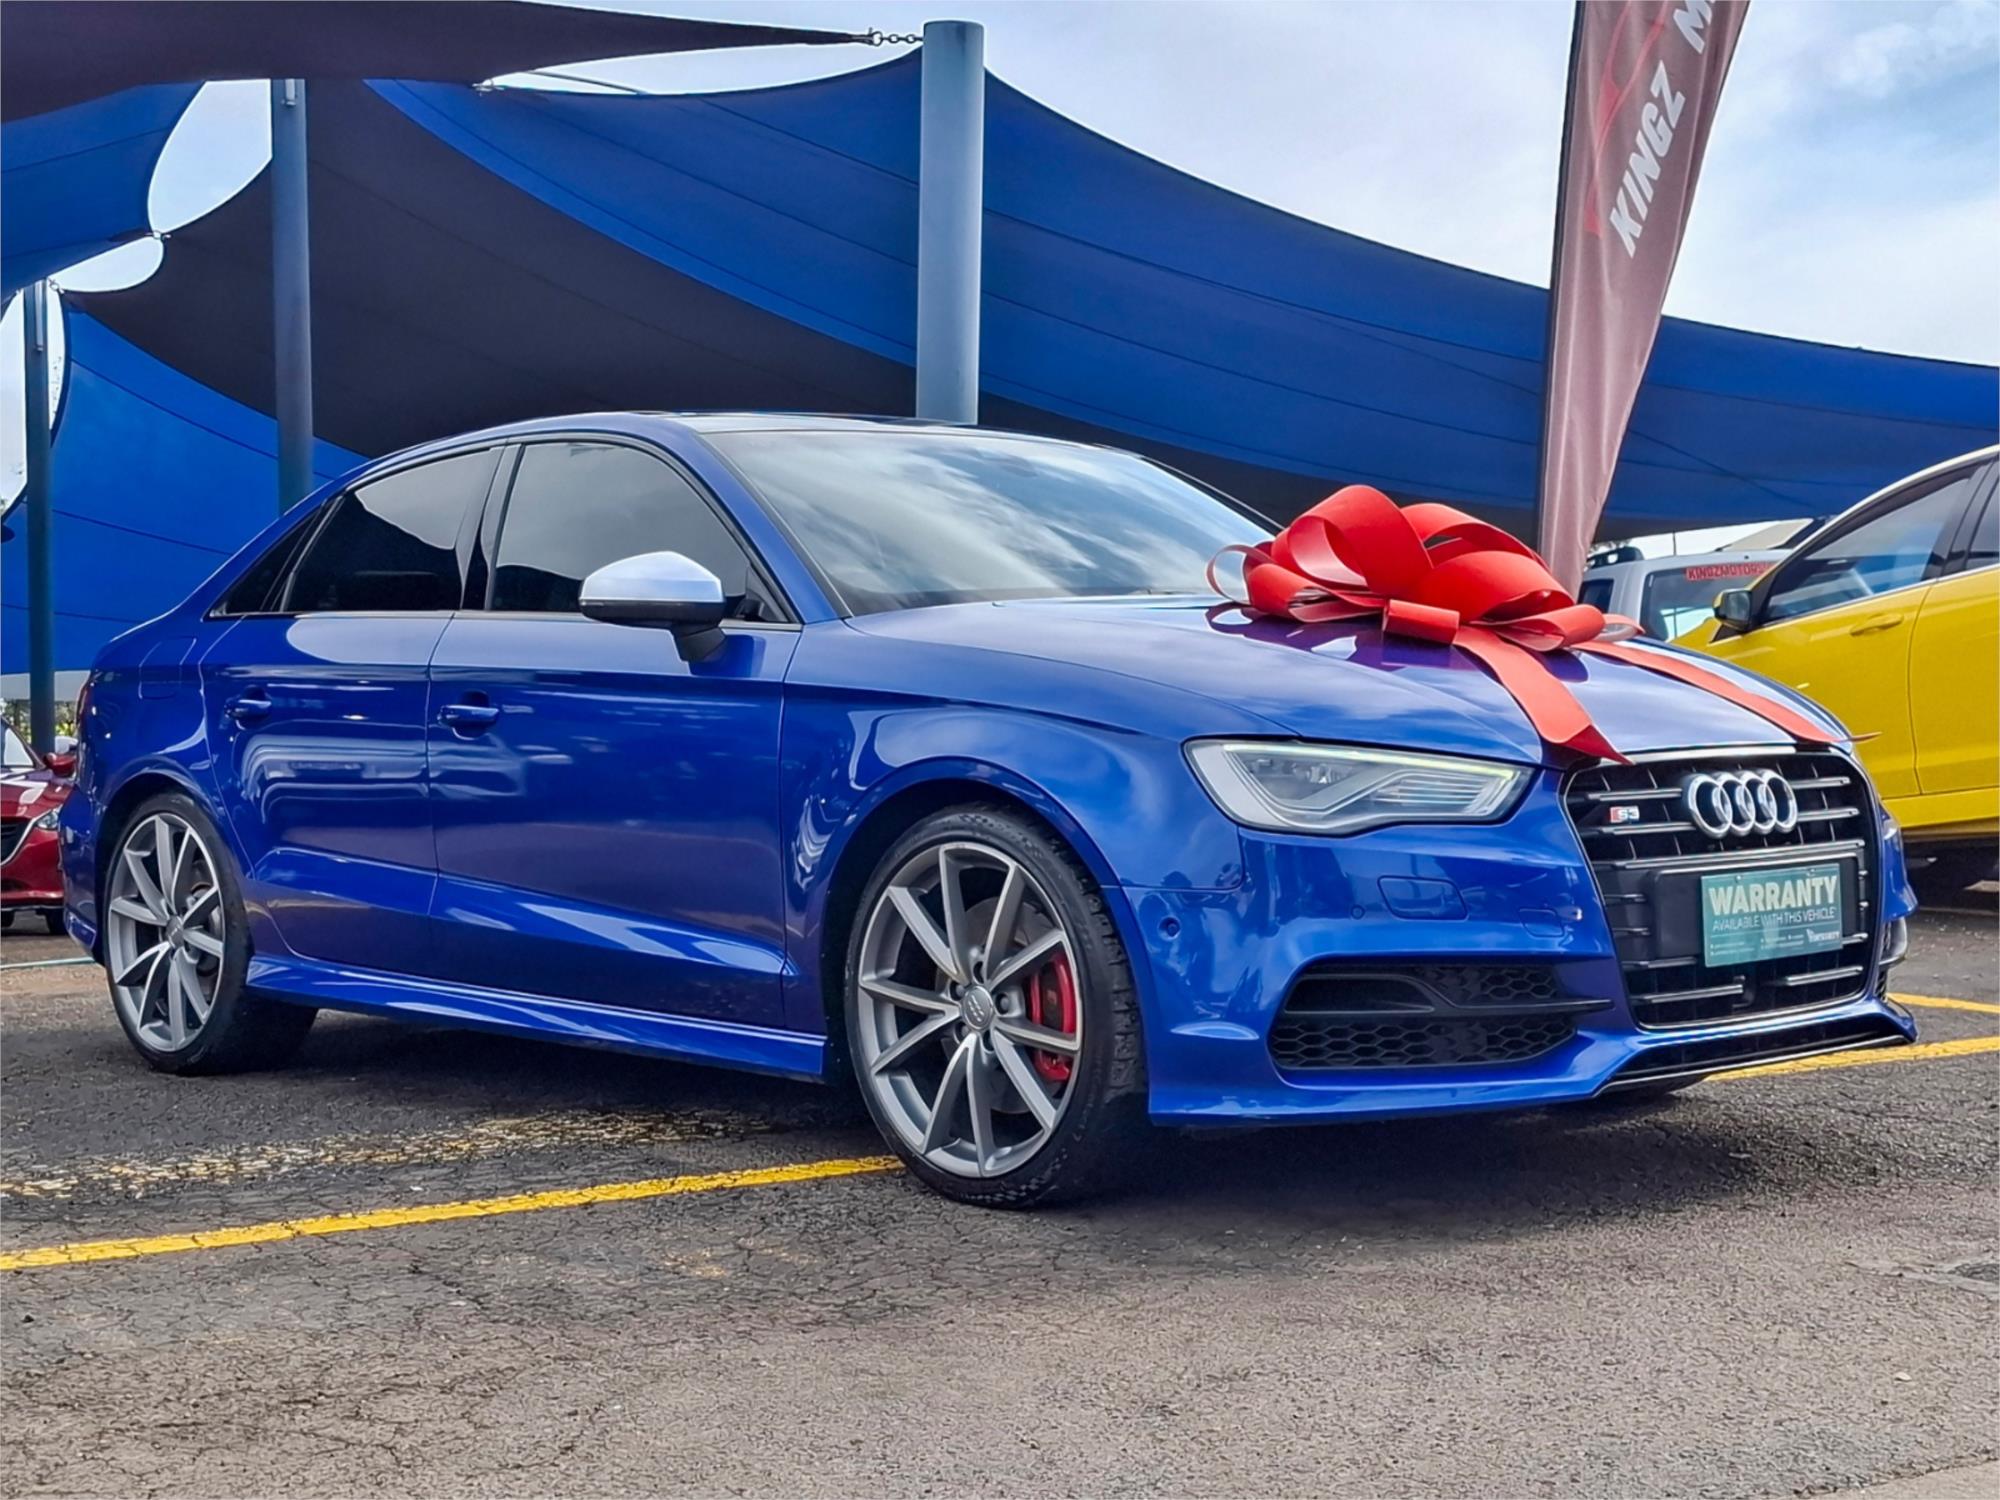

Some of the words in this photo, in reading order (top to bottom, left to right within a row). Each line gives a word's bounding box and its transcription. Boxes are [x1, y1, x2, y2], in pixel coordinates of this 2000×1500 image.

[1609, 59, 1686, 259] KINGZ
[1673, 0, 1716, 54] M
[1616, 806, 1640, 822] S3
[1708, 875, 1837, 916] WARRANTY
[1712, 915, 1761, 932] AVAILABLE
[1761, 912, 1783, 927] WITH
[1783, 909, 1802, 924] THIS
[1802, 906, 1837, 922] VEHICLE
